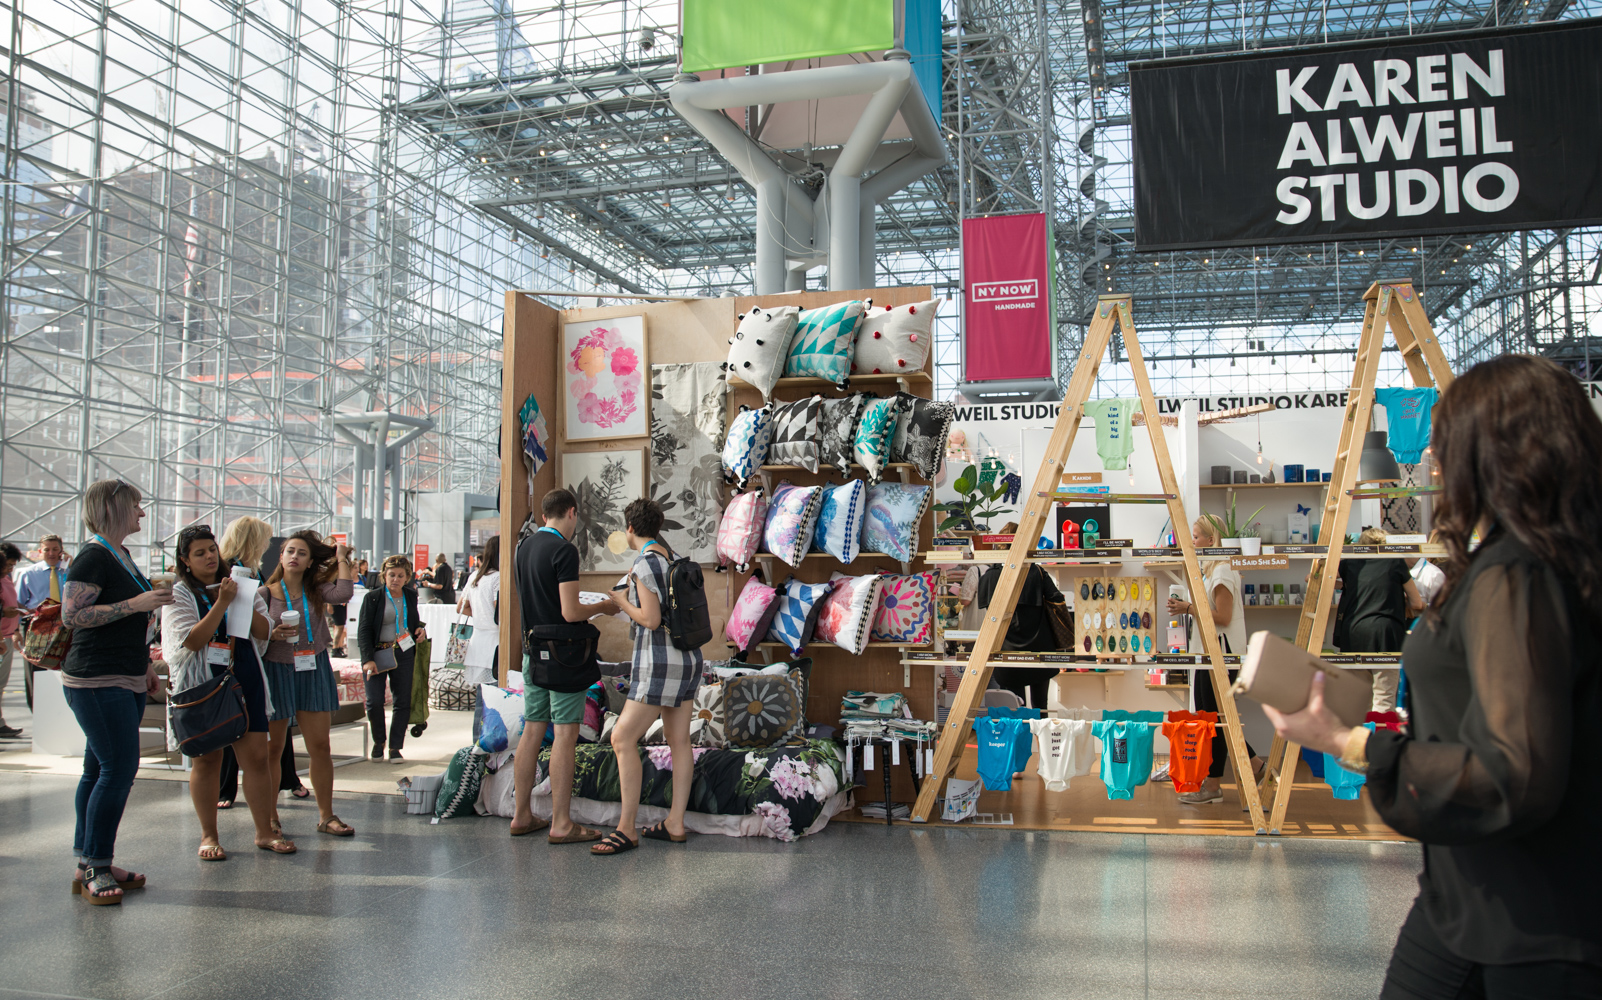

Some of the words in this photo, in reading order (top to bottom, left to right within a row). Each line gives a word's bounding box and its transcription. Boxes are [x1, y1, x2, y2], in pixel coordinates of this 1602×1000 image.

[1275, 48, 1506, 115] KAREN
[1276, 106, 1514, 170] ALWEIL
[1275, 161, 1520, 225] STUDIO
[978, 287, 997, 297] NY
[1000, 284, 1032, 296] NOW
[994, 302, 1036, 311] HANDMADE
